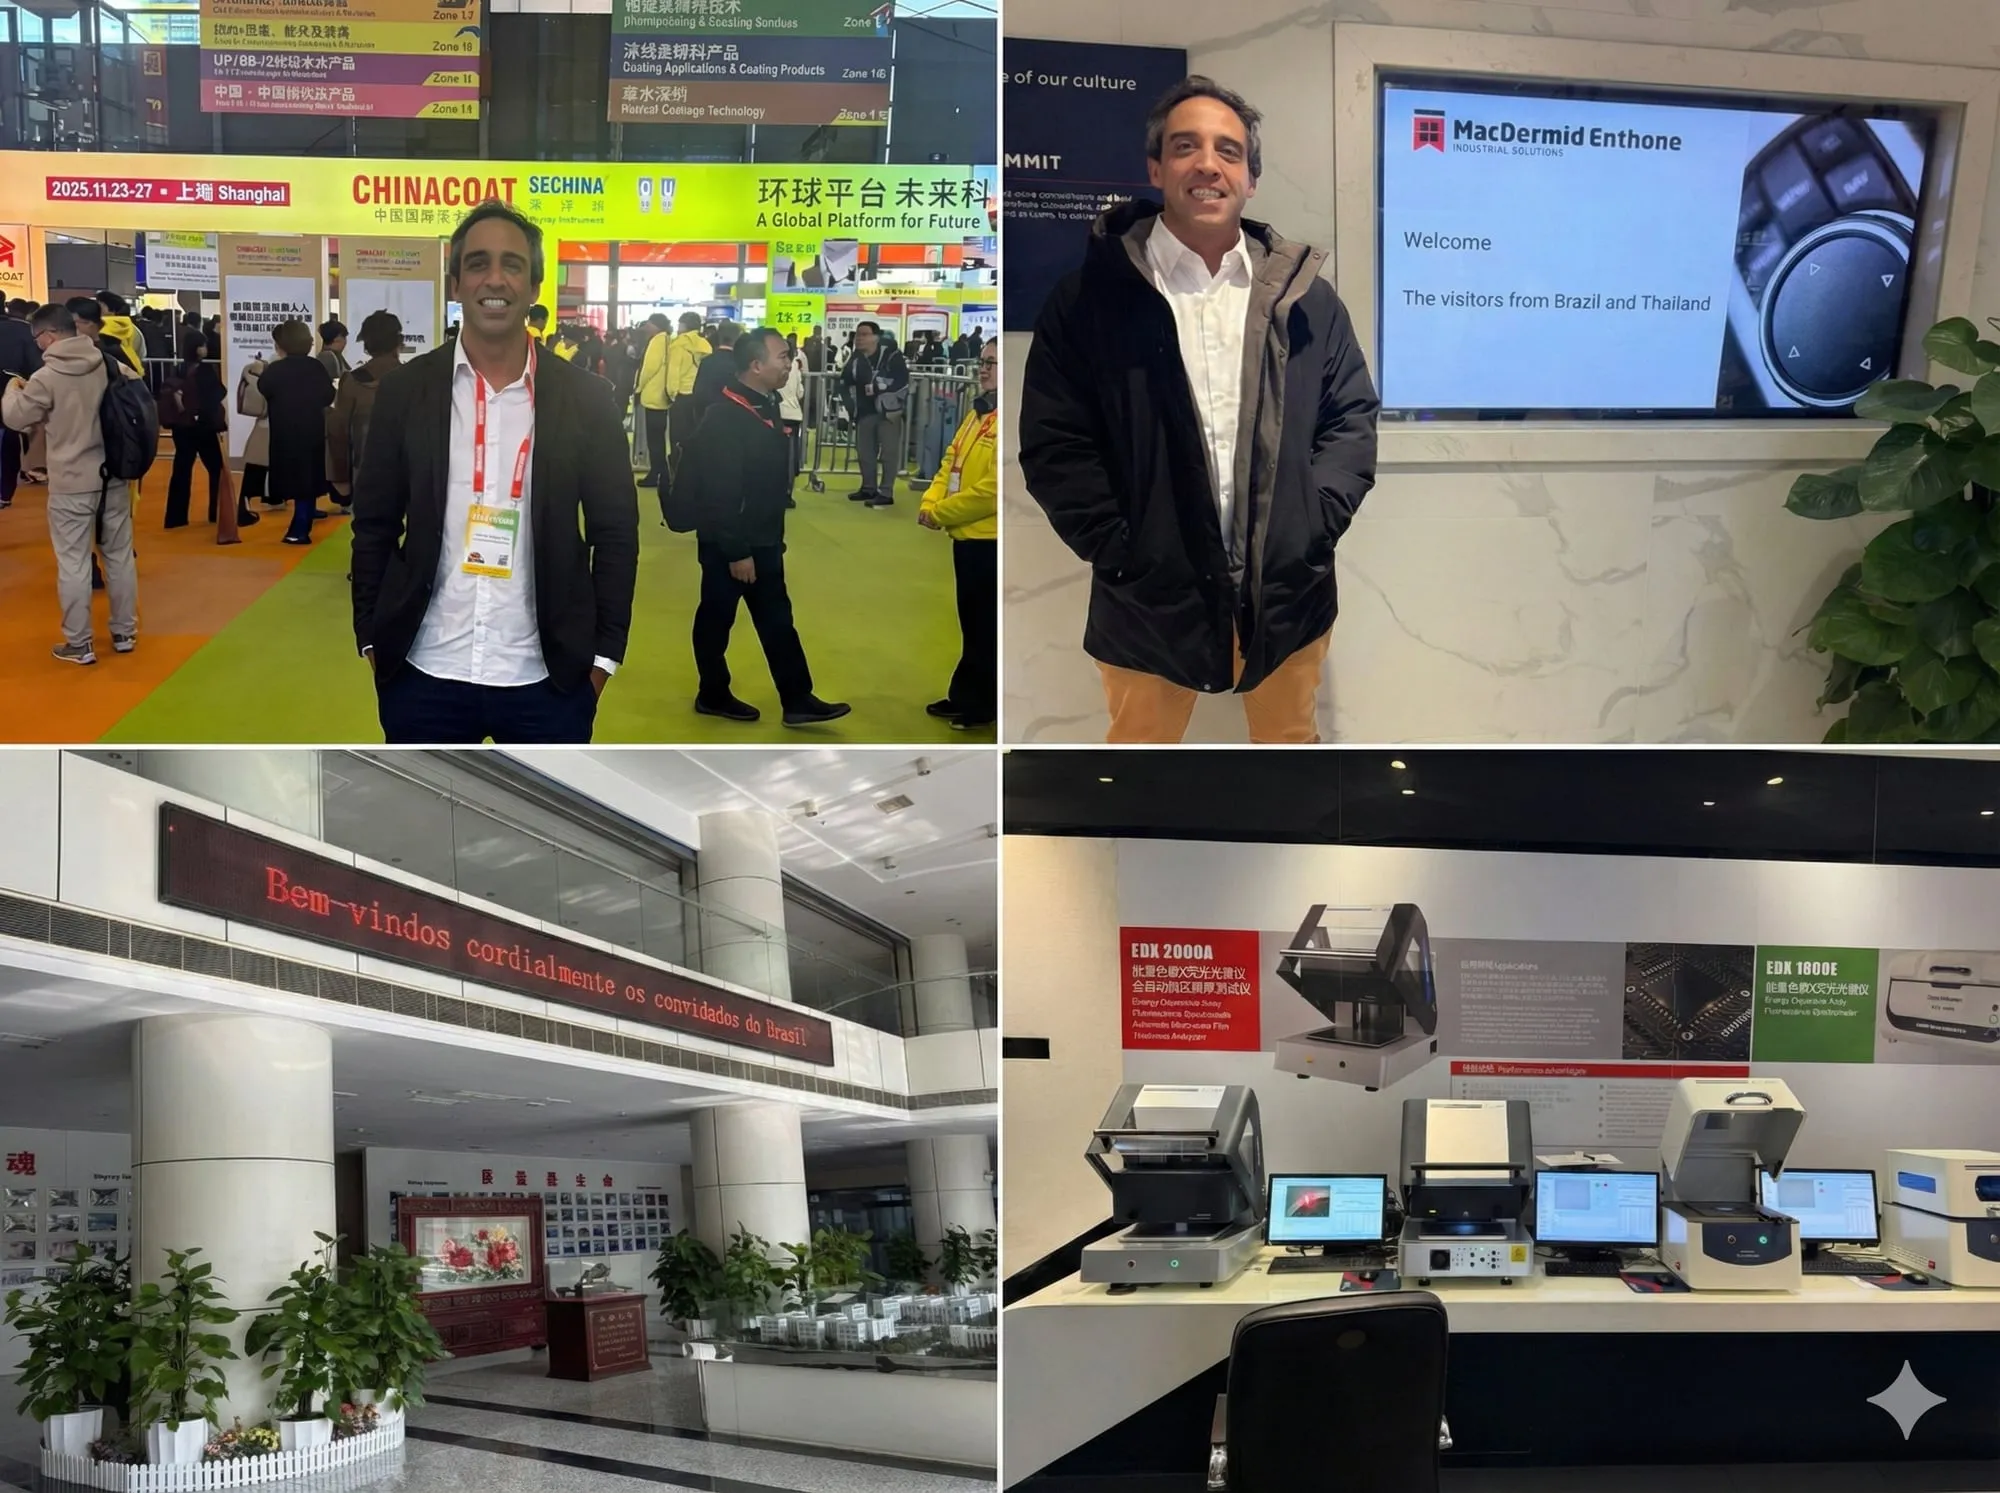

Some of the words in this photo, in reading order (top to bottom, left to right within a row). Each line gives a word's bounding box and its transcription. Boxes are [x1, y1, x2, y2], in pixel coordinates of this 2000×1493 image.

[433, 10, 458, 20] Zone
[698, 16, 706, 27] &
[844, 17, 872, 27] Zone
[433, 41, 459, 51] Zone
[433, 73, 459, 83] Zone
[729, 64, 737, 74] &
[780, 64, 826, 75] Products
[1014, 71, 1033, 84] of
[1038, 74, 1067, 86] our
[1073, 75, 1137, 91] culture
[432, 104, 458, 114] Zone
[707, 105, 766, 119] Technology
[1453, 119, 1585, 146] MacDermid
[1589, 128, 1682, 151] Enthone
[1453, 143, 1508, 155] INDUSTRIAL
[1512, 145, 1564, 157] SOLUTIONS
[1005, 153, 1062, 170] MMIT
[52, 181, 152, 198] 2025.11.23-27
[352, 175, 518, 207] CHINACOAT
[529, 176, 604, 194] SECHINA
[758, 177, 887, 208] 环球平台
[895, 178, 990, 209] 未来科
[756, 213, 767, 227] A
[772, 212, 822, 228] Global
[828, 213, 895, 228] Platform
[901, 213, 924, 228] for
[929, 214, 980, 229] Future
[1404, 231, 1492, 251] Welcome
[0, 272, 24, 281] OAT
[1403, 289, 1436, 306] The
[1440, 290, 1503, 308] visitors
[1509, 291, 1549, 309] from
[1554, 293, 1600, 310] Brazil
[1605, 294, 1636, 310] and
[1641, 295, 1711, 311] Thailand
[265, 866, 451, 950] Bem-vindos
[466, 939, 616, 996] cordialmente
[625, 985, 646, 1004] os
[654, 993, 740, 1029] convidados
[745, 1014, 761, 1035] do
[766, 1018, 807, 1047] Brasil
[1131, 943, 1160, 958] EDX
[1163, 944, 1213, 960] 2000A
[1766, 960, 1792, 975] EDX
